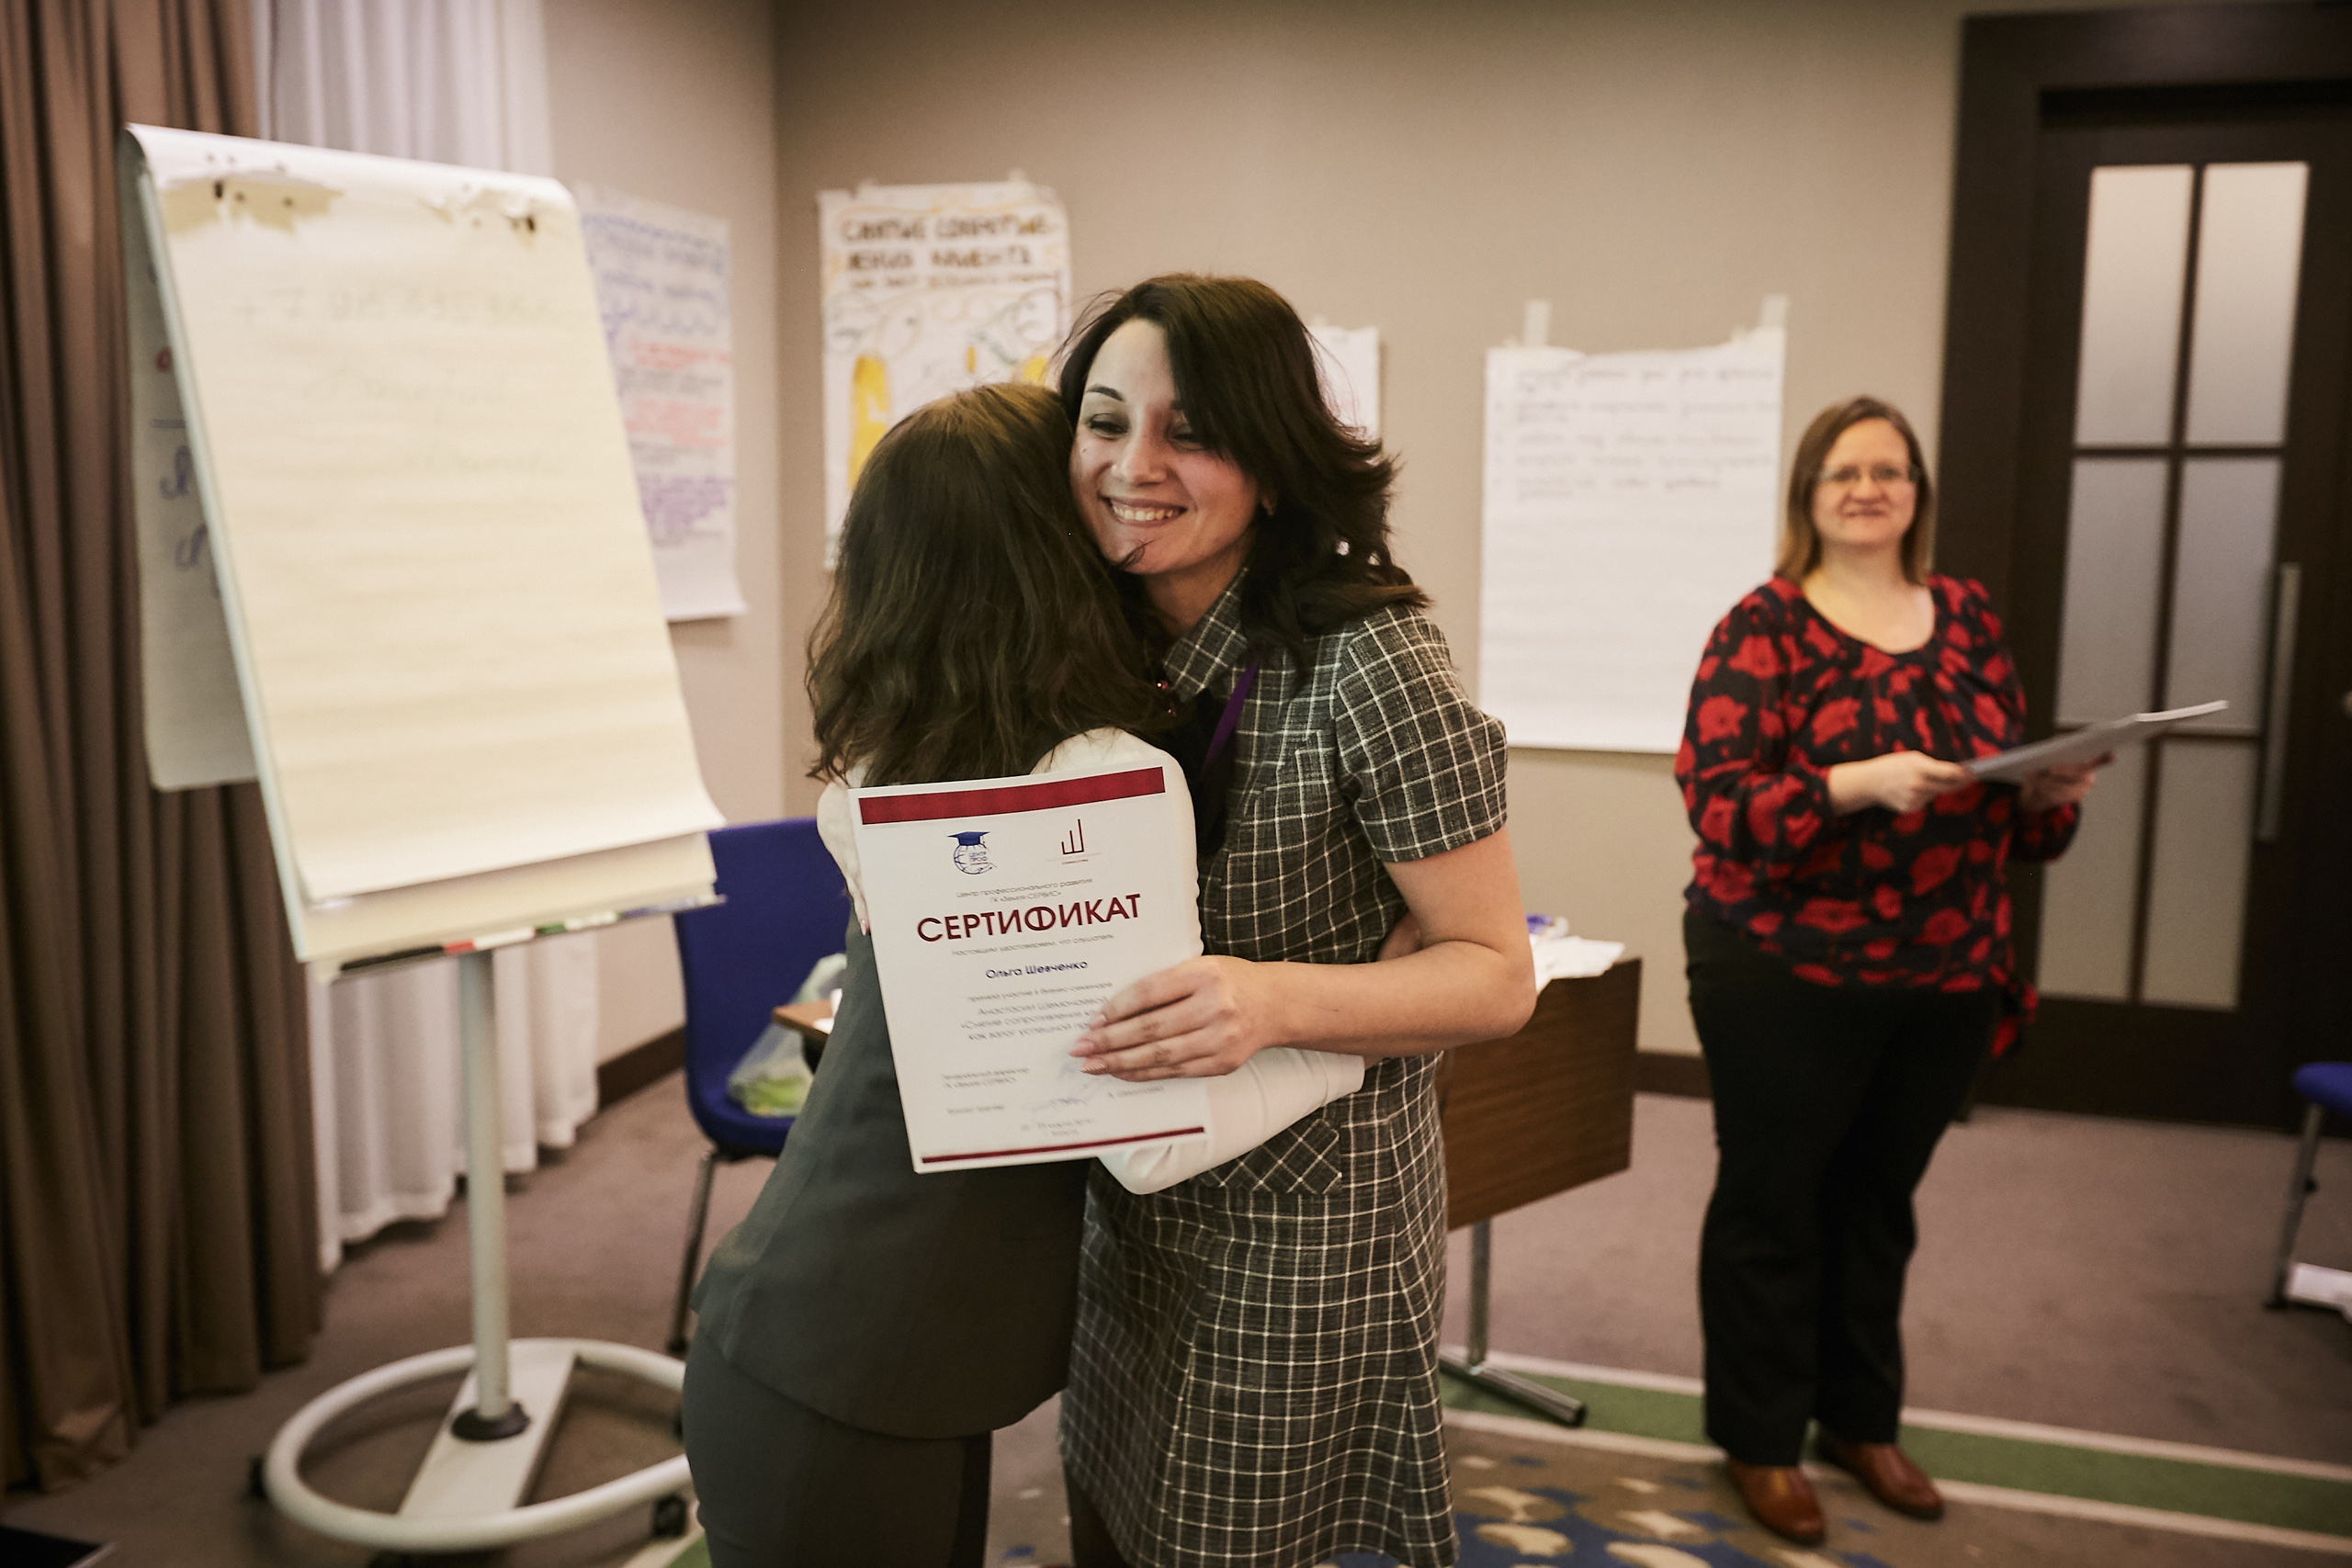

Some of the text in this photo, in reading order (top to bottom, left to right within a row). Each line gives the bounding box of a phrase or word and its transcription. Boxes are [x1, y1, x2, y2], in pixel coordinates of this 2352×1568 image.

[956, 878, 1093, 898] Центр профессионального развития
[916, 894, 1141, 942] СЕРТИФИКАТ
[985, 961, 1088, 979] Ольга Шевченко
